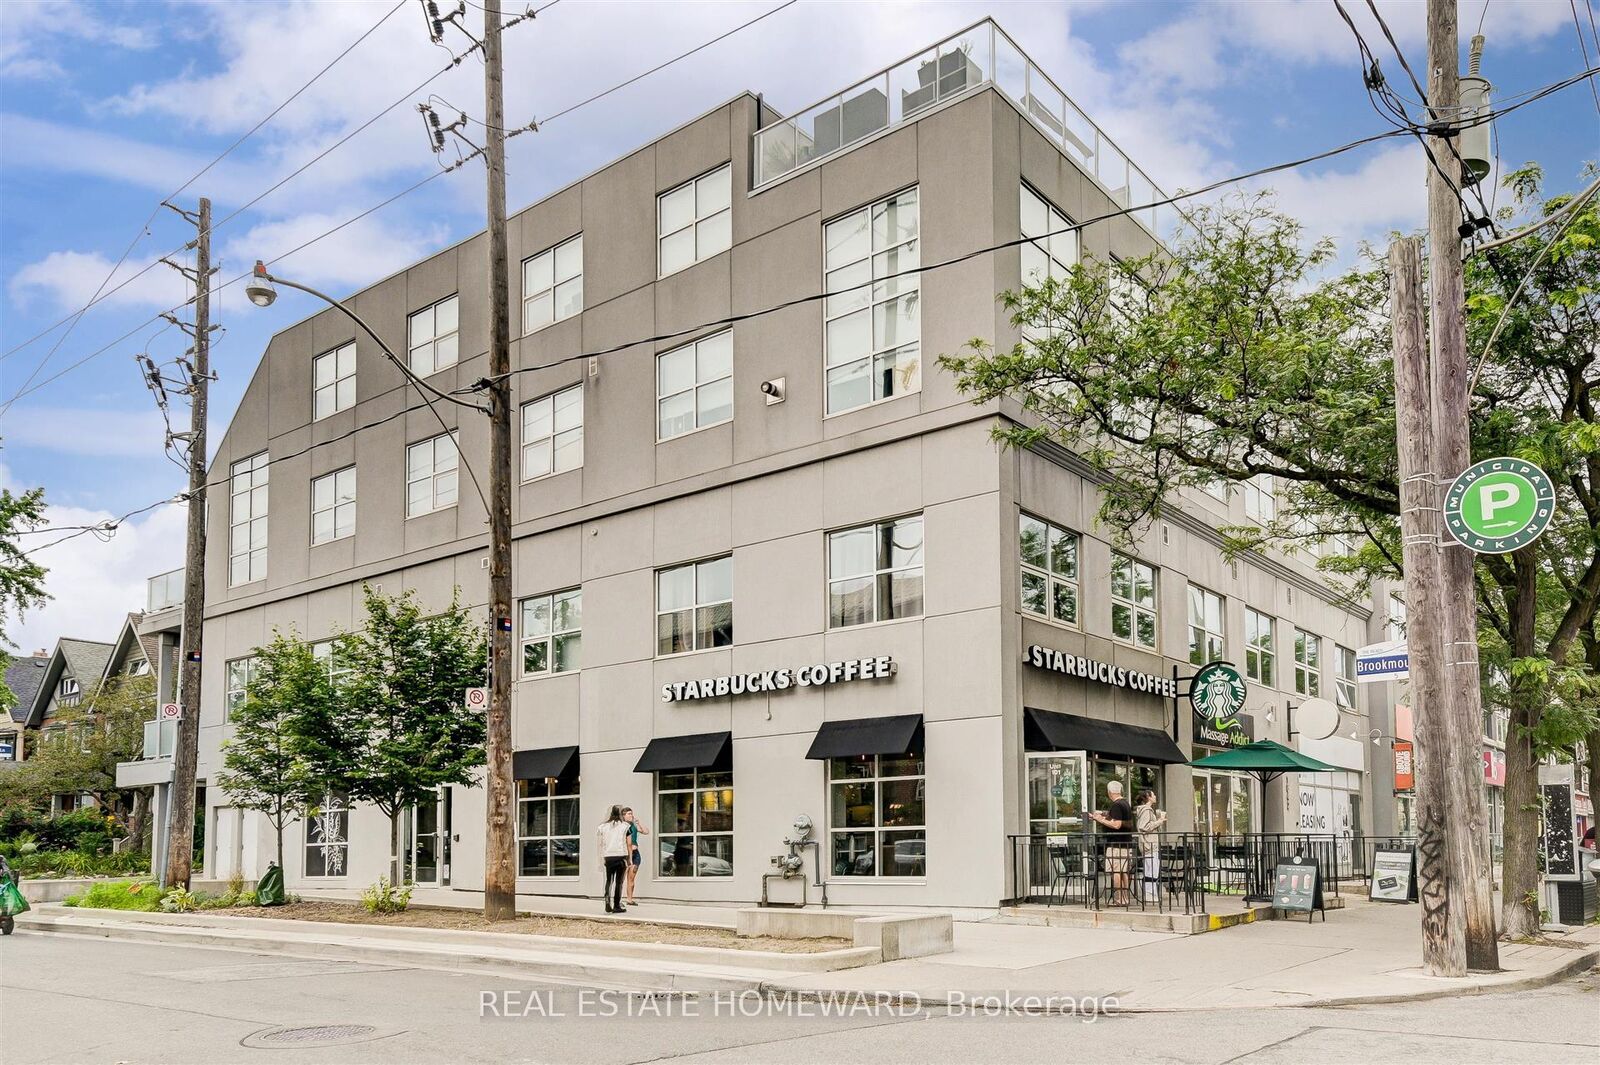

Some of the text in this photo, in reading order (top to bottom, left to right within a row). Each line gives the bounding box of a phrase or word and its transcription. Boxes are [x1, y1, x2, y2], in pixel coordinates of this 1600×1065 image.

[1450, 463, 1548, 508] MUNICIPAL
[1479, 483, 1520, 521] P
[1451, 508, 1548, 548] PARKING
[661, 656, 894, 703] STARBUCKS COFFEE
[1031, 645, 1176, 699] STARBUCKS COFFEE
[1200, 725, 1250, 746] Massage Addict
[1300, 814, 1326, 829] EASING
